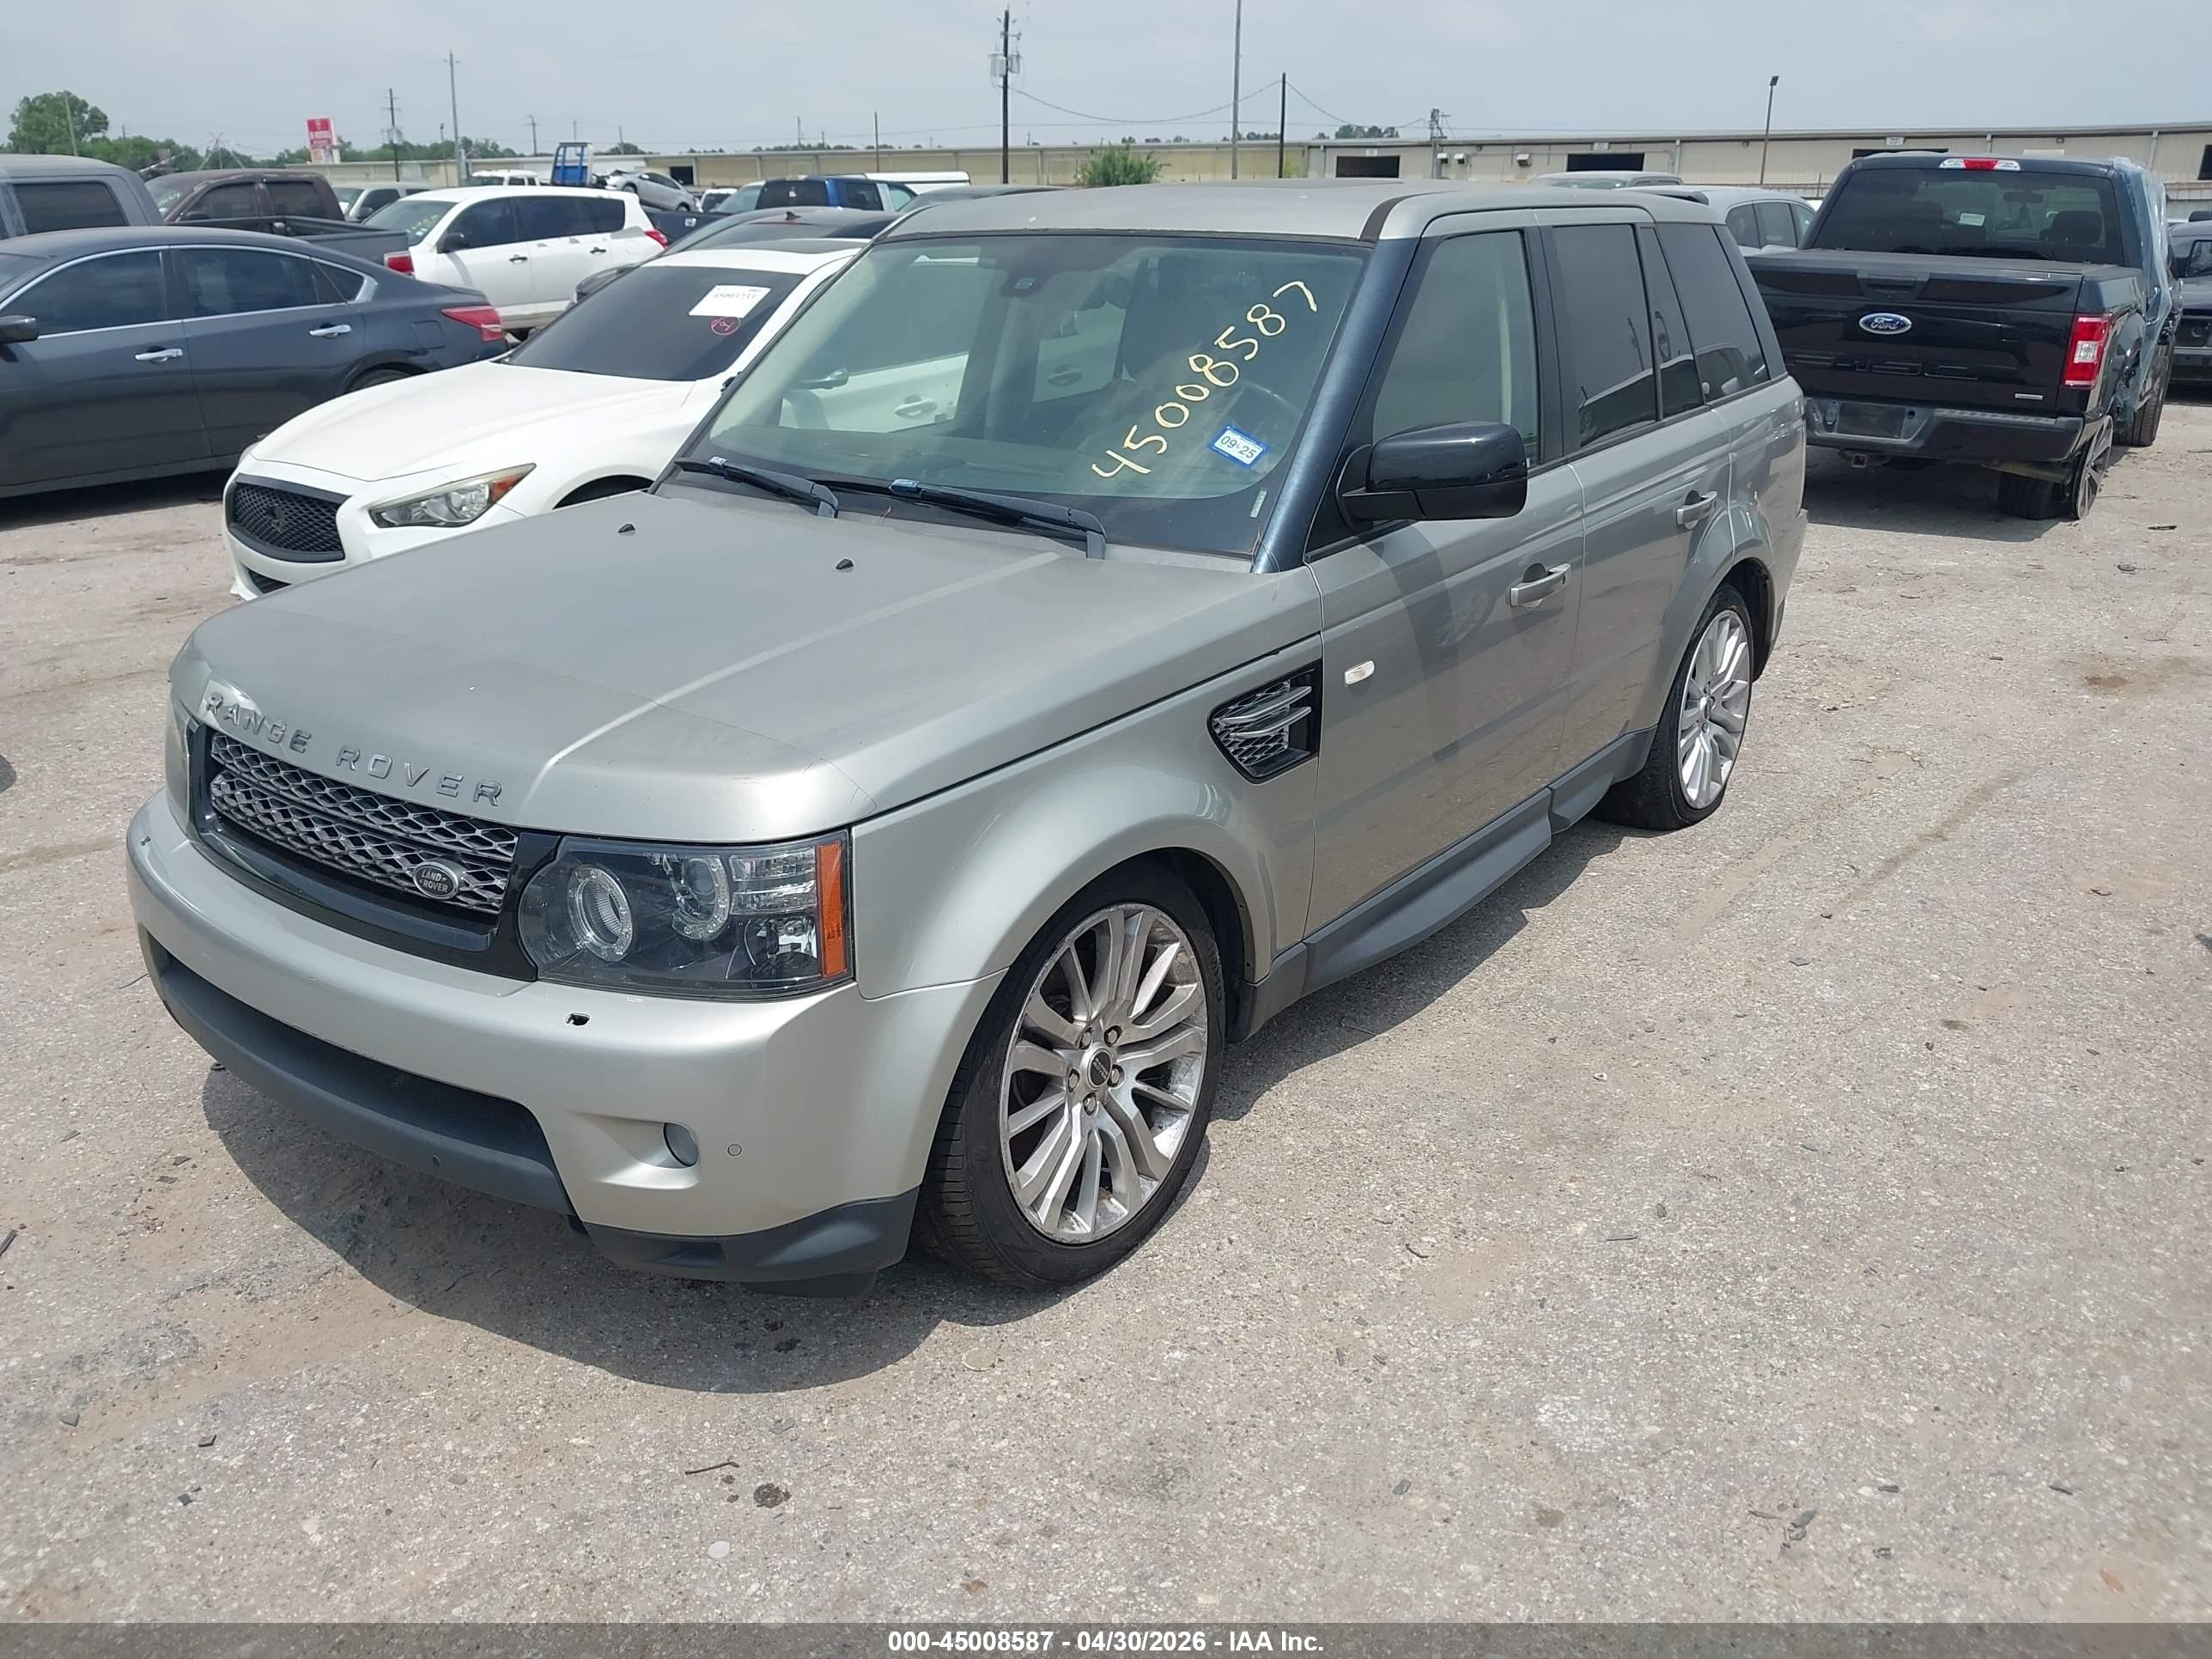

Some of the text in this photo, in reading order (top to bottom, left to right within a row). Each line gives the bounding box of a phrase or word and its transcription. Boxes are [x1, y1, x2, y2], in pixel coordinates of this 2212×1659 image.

[1870, 317, 1900, 330] Ford
[1091, 281, 1318, 477] 45008587
[205, 692, 502, 806] RANGE ROVER
[422, 870, 442, 882] LAND
[422, 879, 448, 893] ROVER
